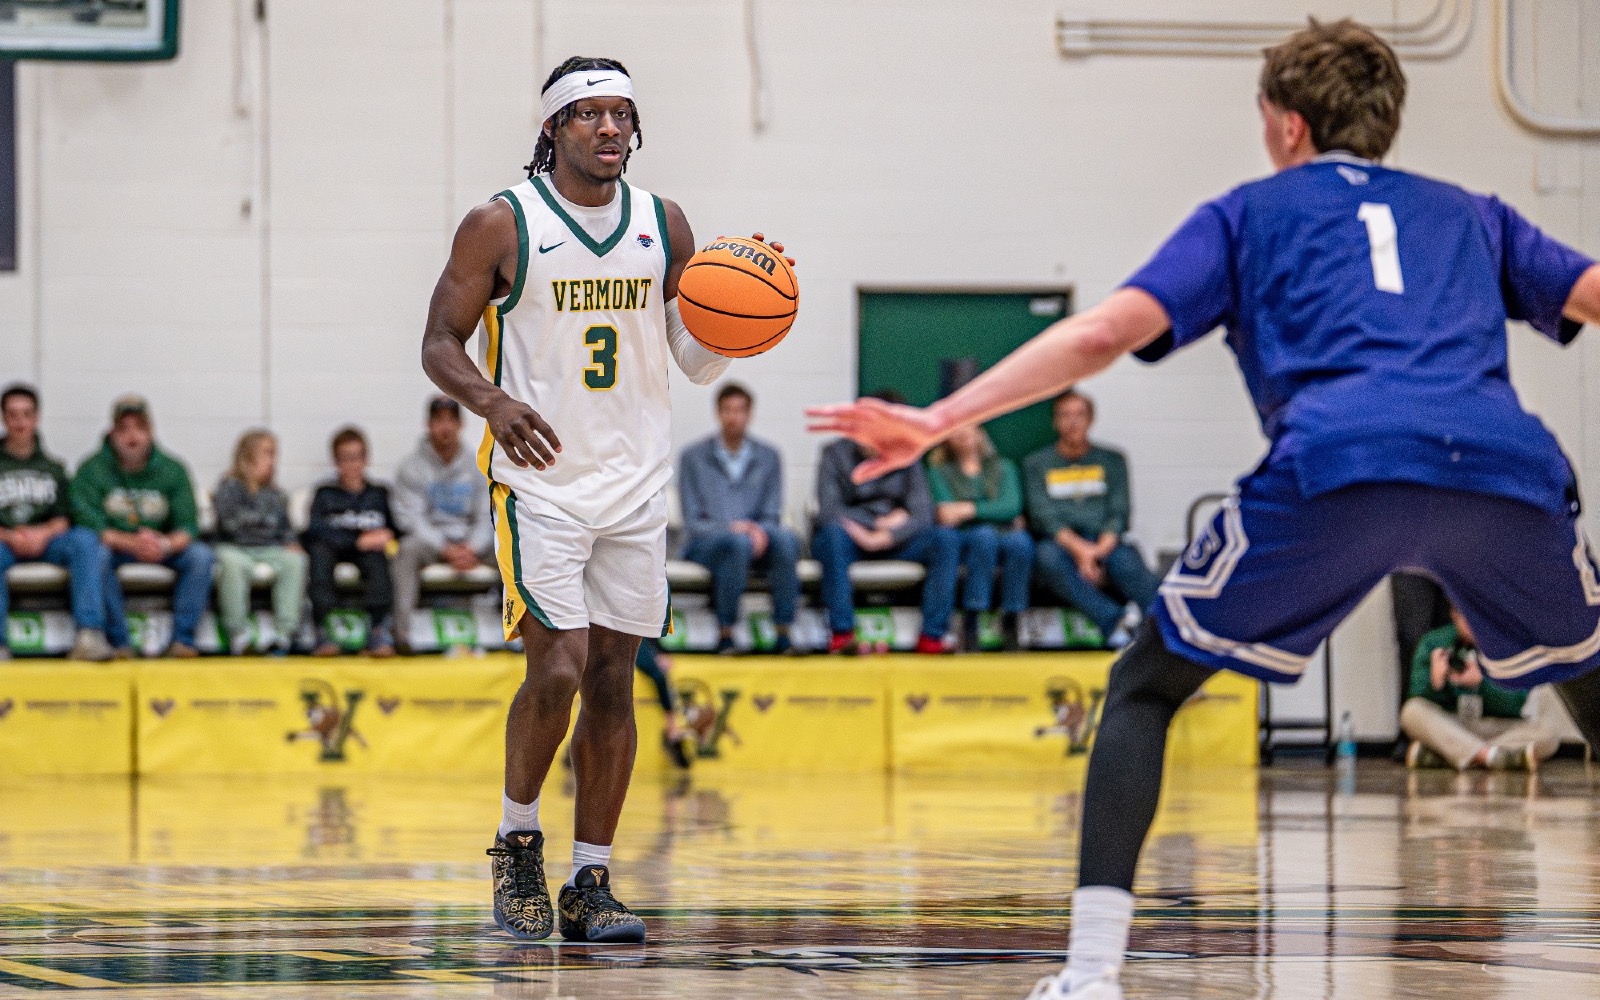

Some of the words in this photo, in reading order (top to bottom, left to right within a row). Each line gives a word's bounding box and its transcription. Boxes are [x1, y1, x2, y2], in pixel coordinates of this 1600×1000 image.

[702, 242, 776, 276] Wilson
[1357, 202, 1404, 294] 1
[551, 278, 652, 312] VERMONT
[582, 323, 619, 391] 3
